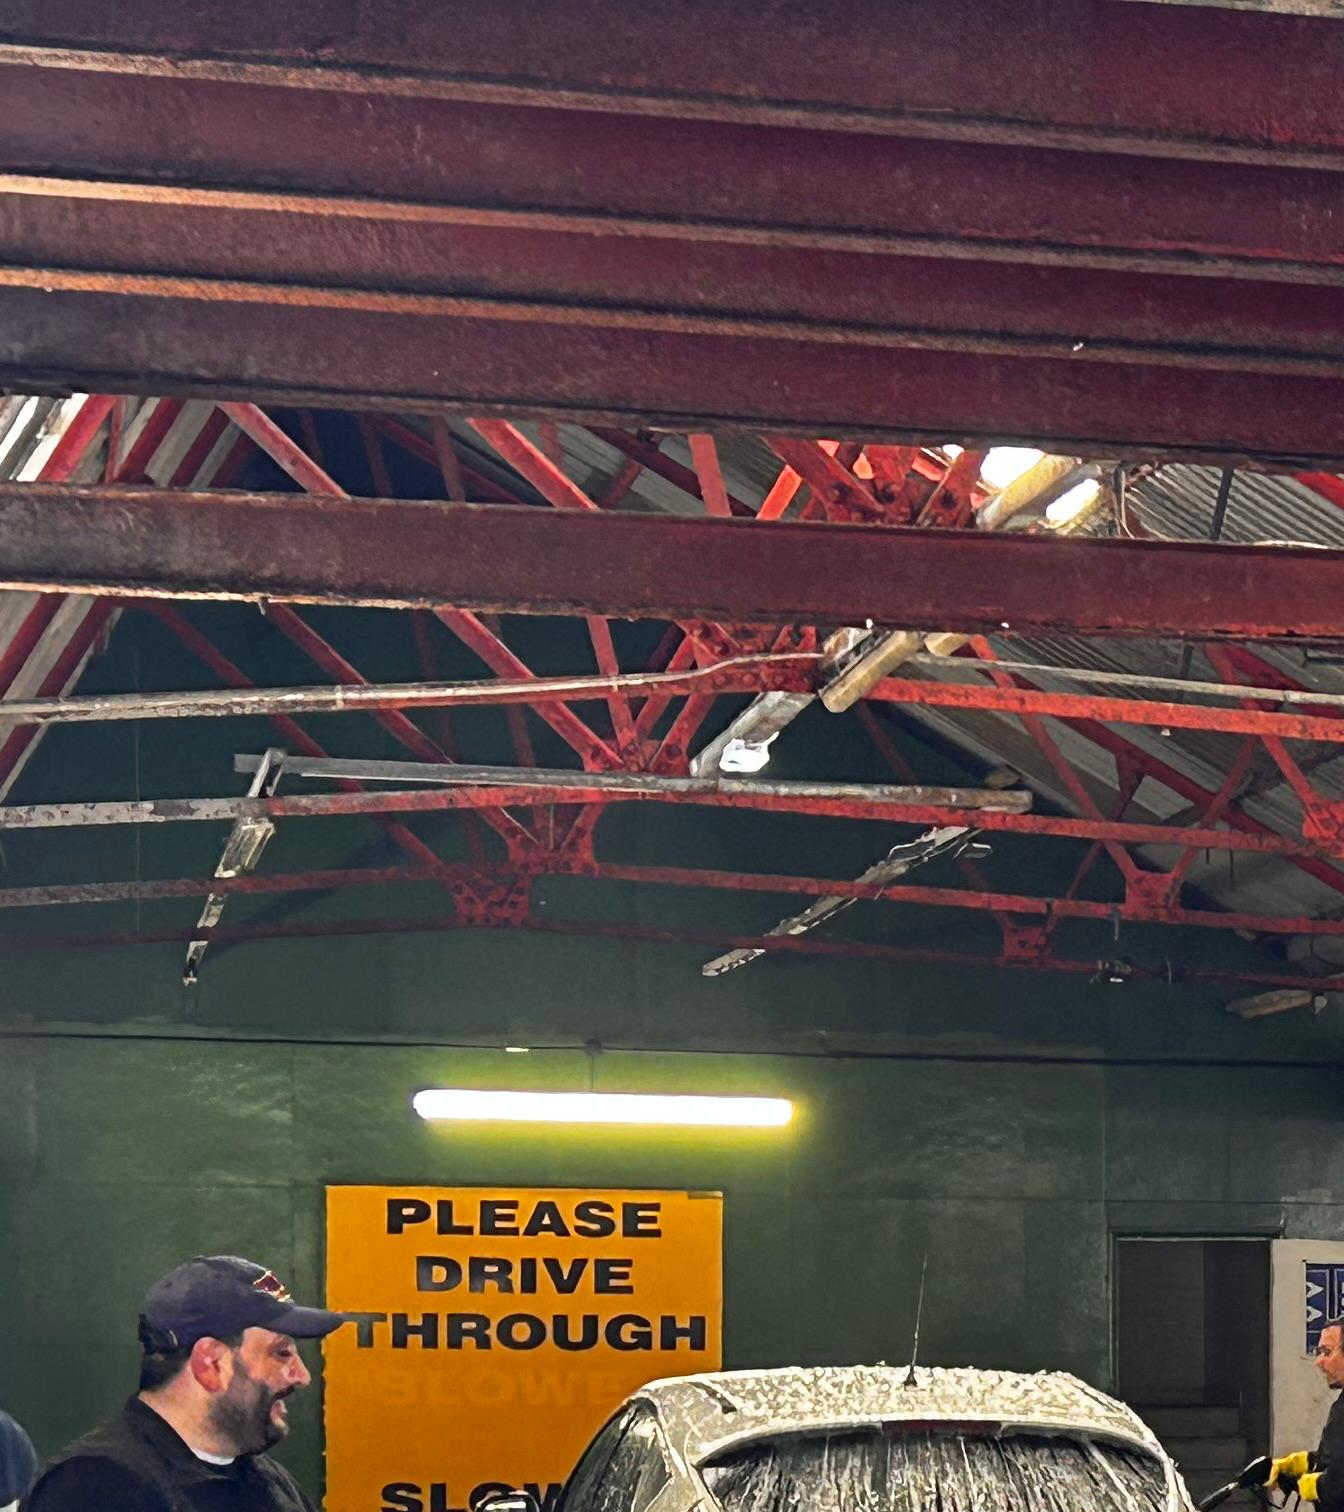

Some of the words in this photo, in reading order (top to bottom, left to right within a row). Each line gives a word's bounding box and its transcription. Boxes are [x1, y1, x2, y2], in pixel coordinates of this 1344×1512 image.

[386, 1198, 662, 1238] PLEASE
[416, 1256, 634, 1294] DRIVE
[342, 1312, 706, 1351] THROUGH
